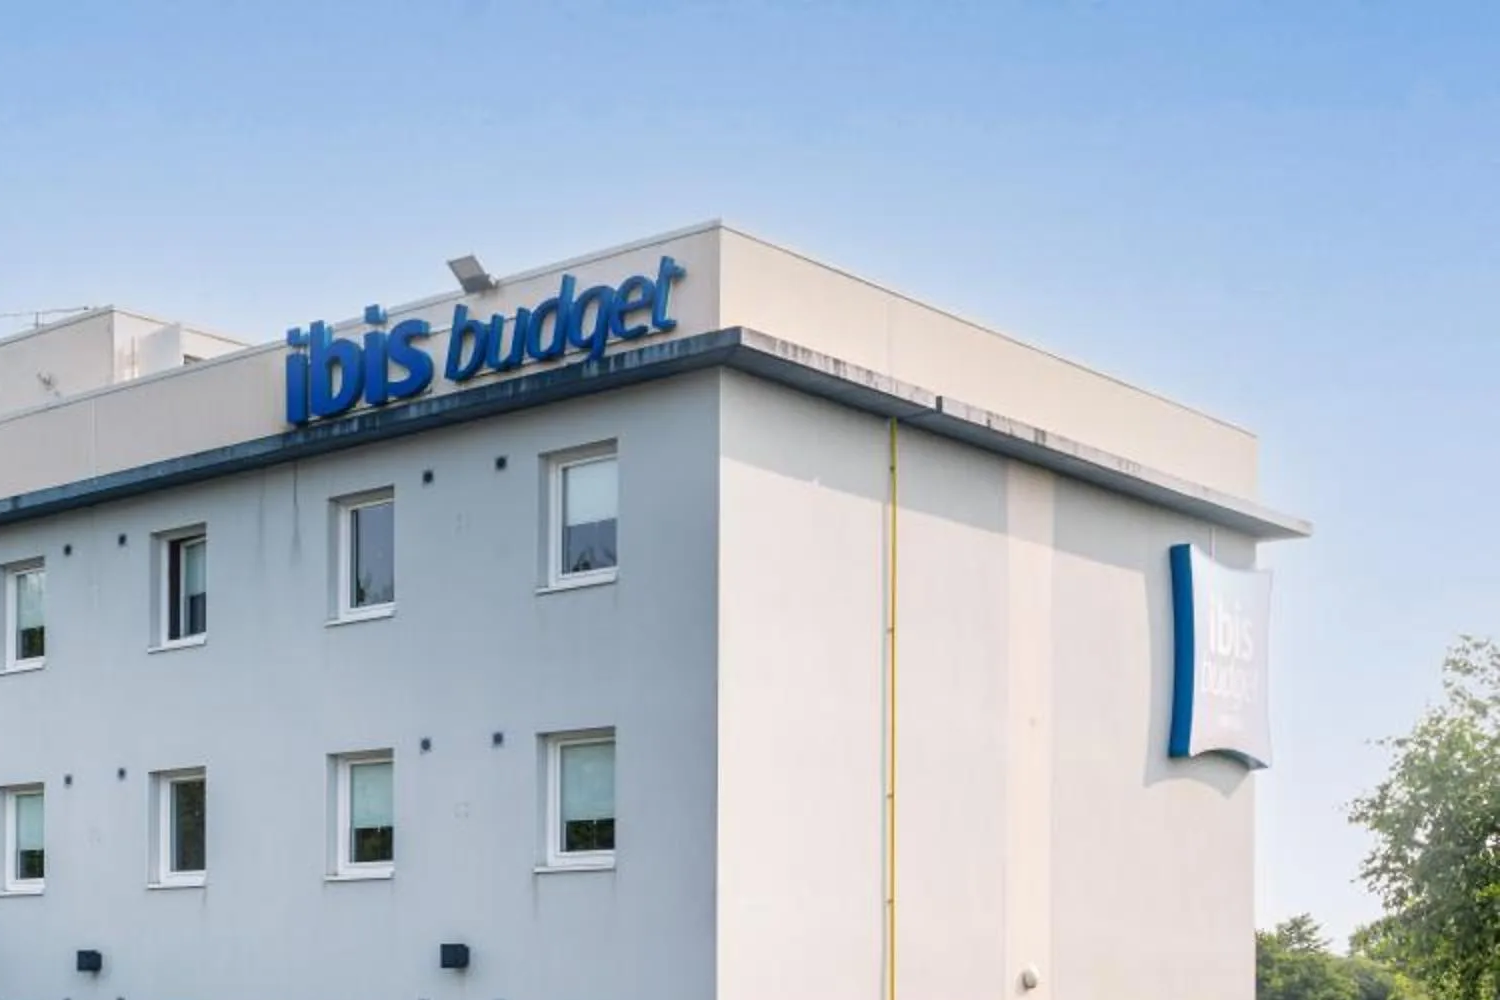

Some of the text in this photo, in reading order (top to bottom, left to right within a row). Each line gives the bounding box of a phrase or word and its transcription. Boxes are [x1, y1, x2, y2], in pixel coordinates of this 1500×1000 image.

[286, 256, 687, 424] ibis budget
[1209, 591, 1253, 661] ibis
